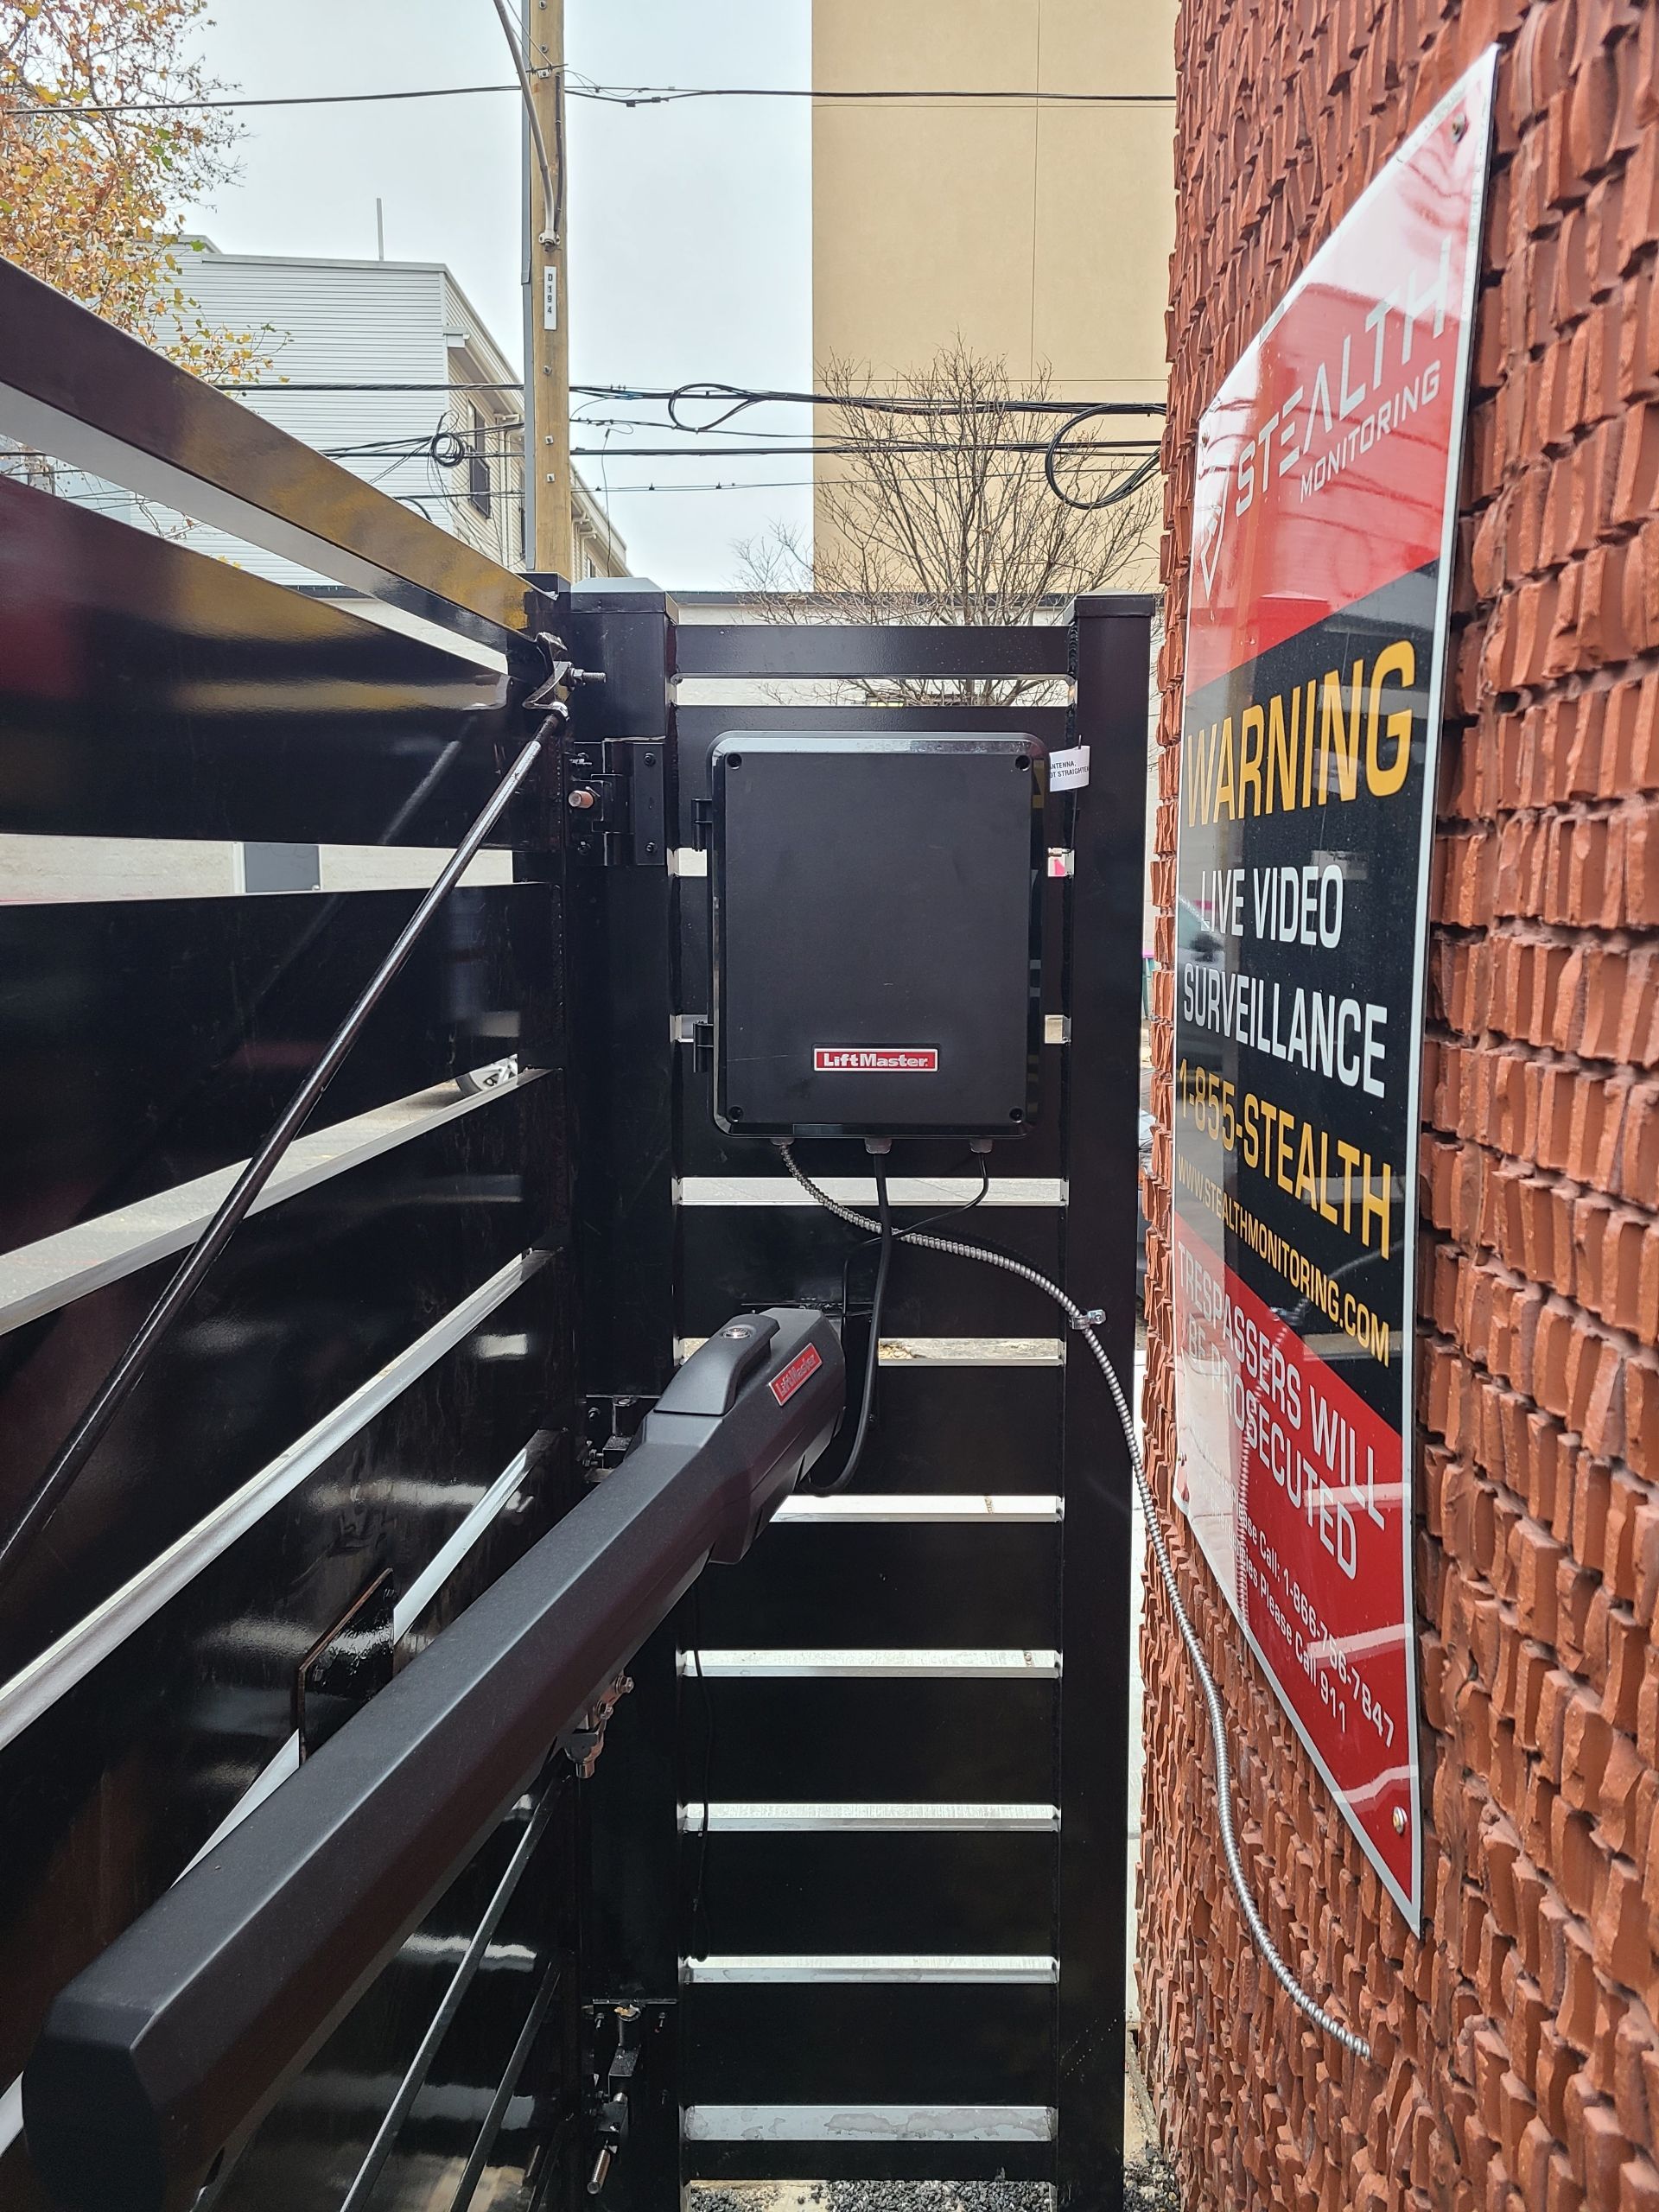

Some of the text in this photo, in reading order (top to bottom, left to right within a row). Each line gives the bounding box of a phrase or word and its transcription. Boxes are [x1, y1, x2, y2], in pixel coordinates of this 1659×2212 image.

[1235, 233, 1452, 518] STEALTH
[1300, 359, 1441, 504] MONITORING
[1186, 640, 1415, 828] WARNING
[1200, 864, 1344, 949] LIVE VIDEO
[823, 1052, 929, 1068] LiftMaster
[1183, 963, 1388, 1099] SURVEILLANCE
[1179, 1058, 1391, 1262] 1-855-STEALTH
[1178, 1153, 1389, 1369] WWW.STEALTHMONITORING.COM
[1178, 1239, 1302, 1431] TRESPASSERS
[1309, 1384, 1385, 1531] WILL
[1188, 1313, 1207, 1364] BE
[1211, 1342, 1357, 1580] PROSECUTED
[1260, 1529, 1281, 1583] Call:
[1283, 1567, 1395, 1749] 1-866-756-7847
[1261, 1573, 1293, 1646] Please
[1295, 1633, 1318, 1687] Call
[1320, 1670, 1346, 1734] 911
